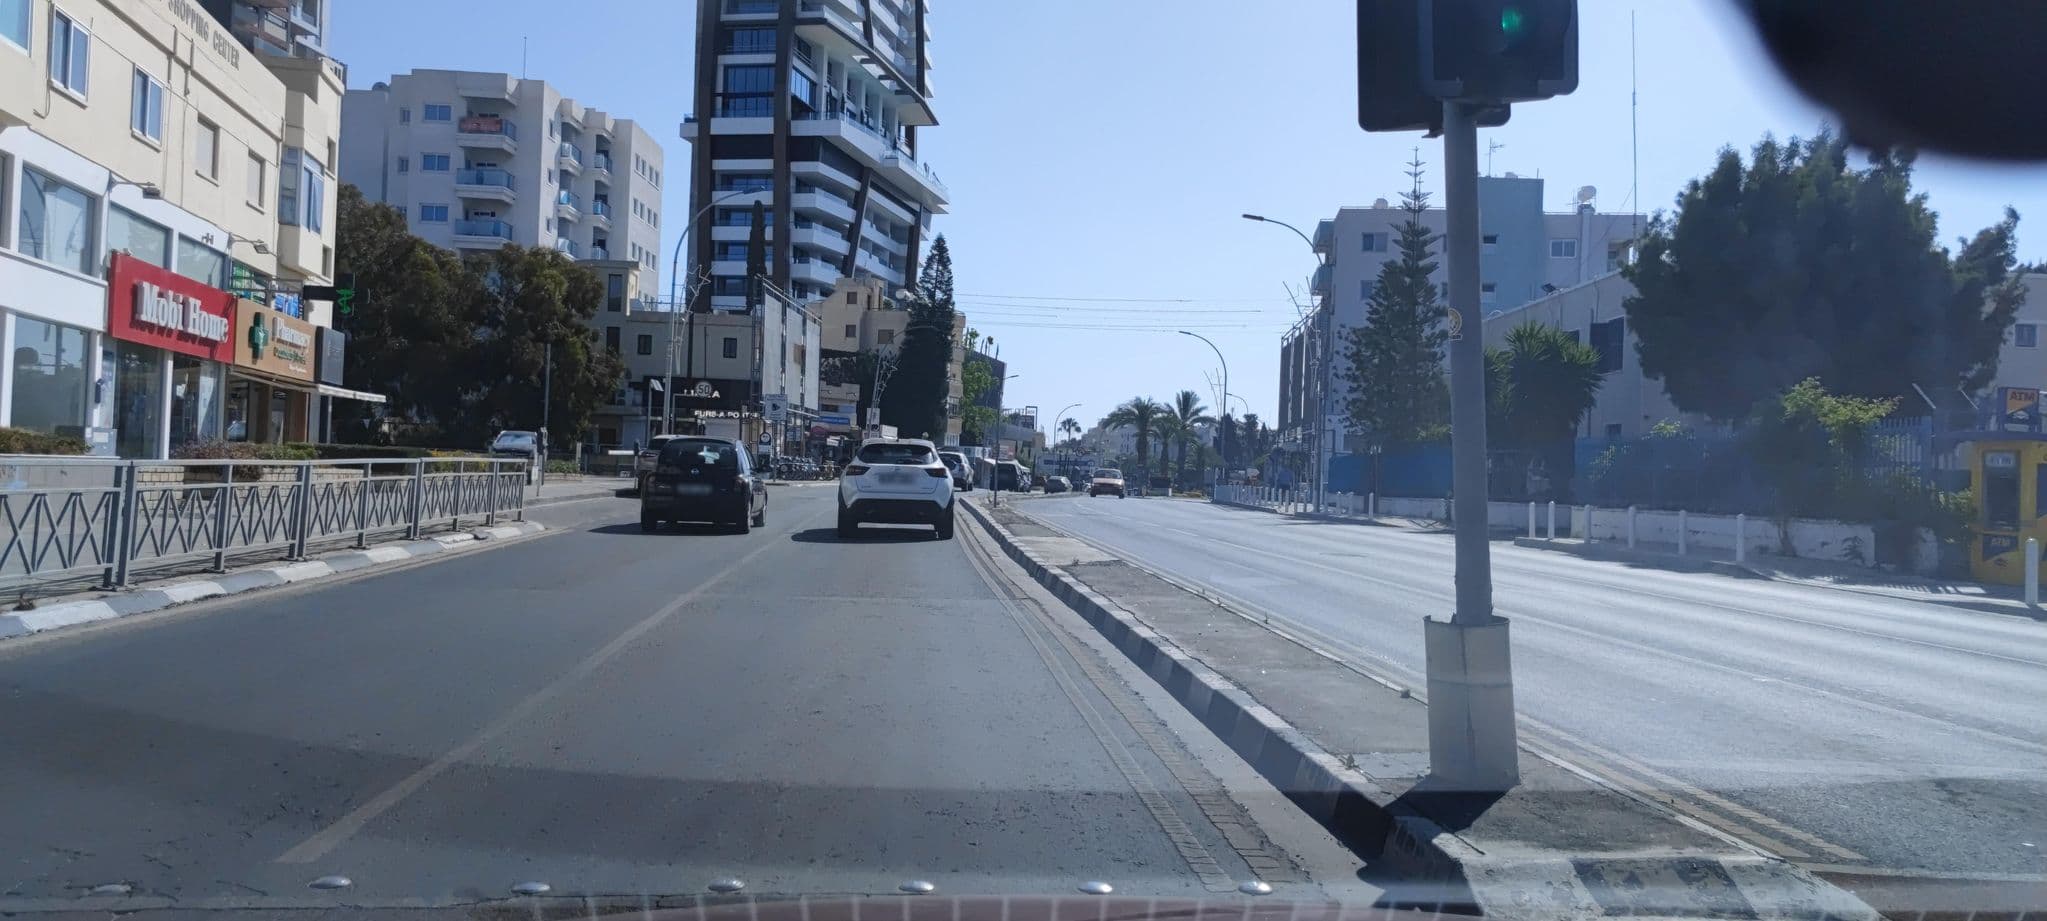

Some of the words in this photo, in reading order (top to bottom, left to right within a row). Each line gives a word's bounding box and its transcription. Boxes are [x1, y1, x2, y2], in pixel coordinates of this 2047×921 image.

[168, 0, 209, 42] SHOPPING
[213, 30, 240, 71] CENTER
[137, 280, 184, 332] Mobi
[184, 295, 229, 344] Home
[698, 384, 710, 394] 50
[2009, 391, 2035, 401] ATM
